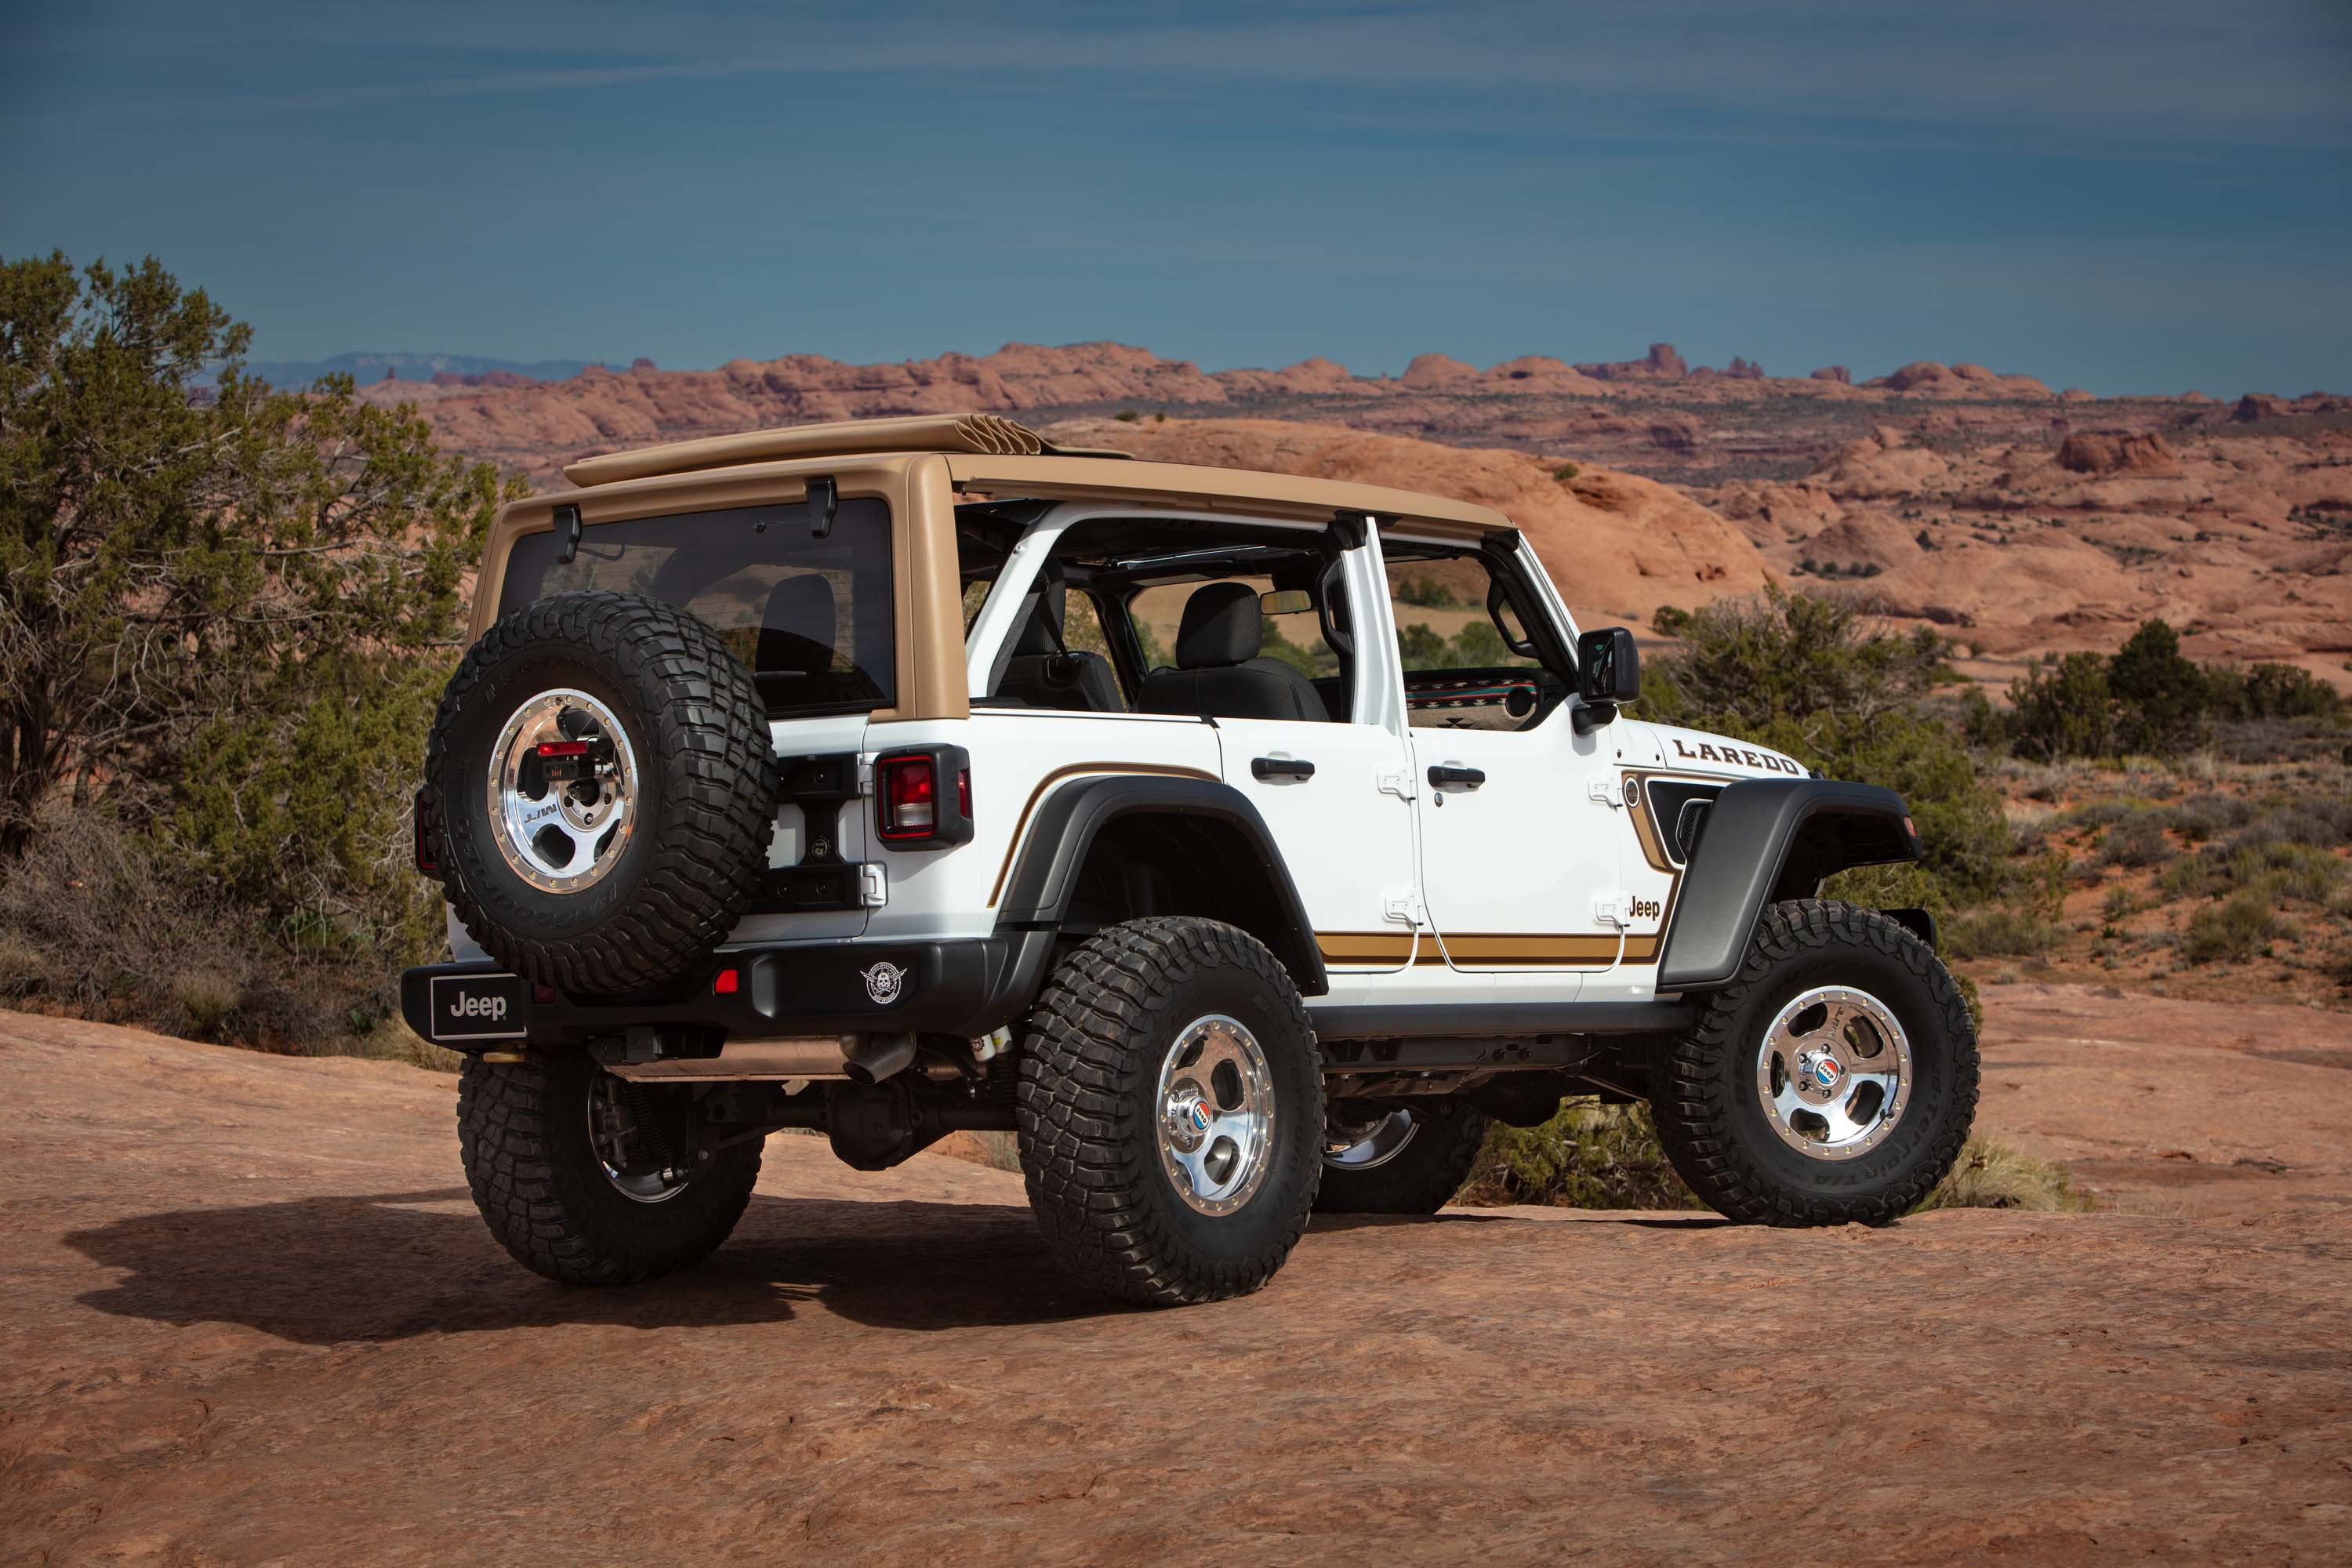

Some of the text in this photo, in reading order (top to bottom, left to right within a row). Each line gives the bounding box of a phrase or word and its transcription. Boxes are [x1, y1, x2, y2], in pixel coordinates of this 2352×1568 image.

[1672, 739, 1799, 776] LAREDO
[524, 803, 557, 823] M/T
[1629, 895, 1661, 921] Jeep
[449, 991, 506, 1022] Jeep
[1820, 1065, 1834, 1079] Jeep
[1196, 1107, 1207, 1123] Jeep
